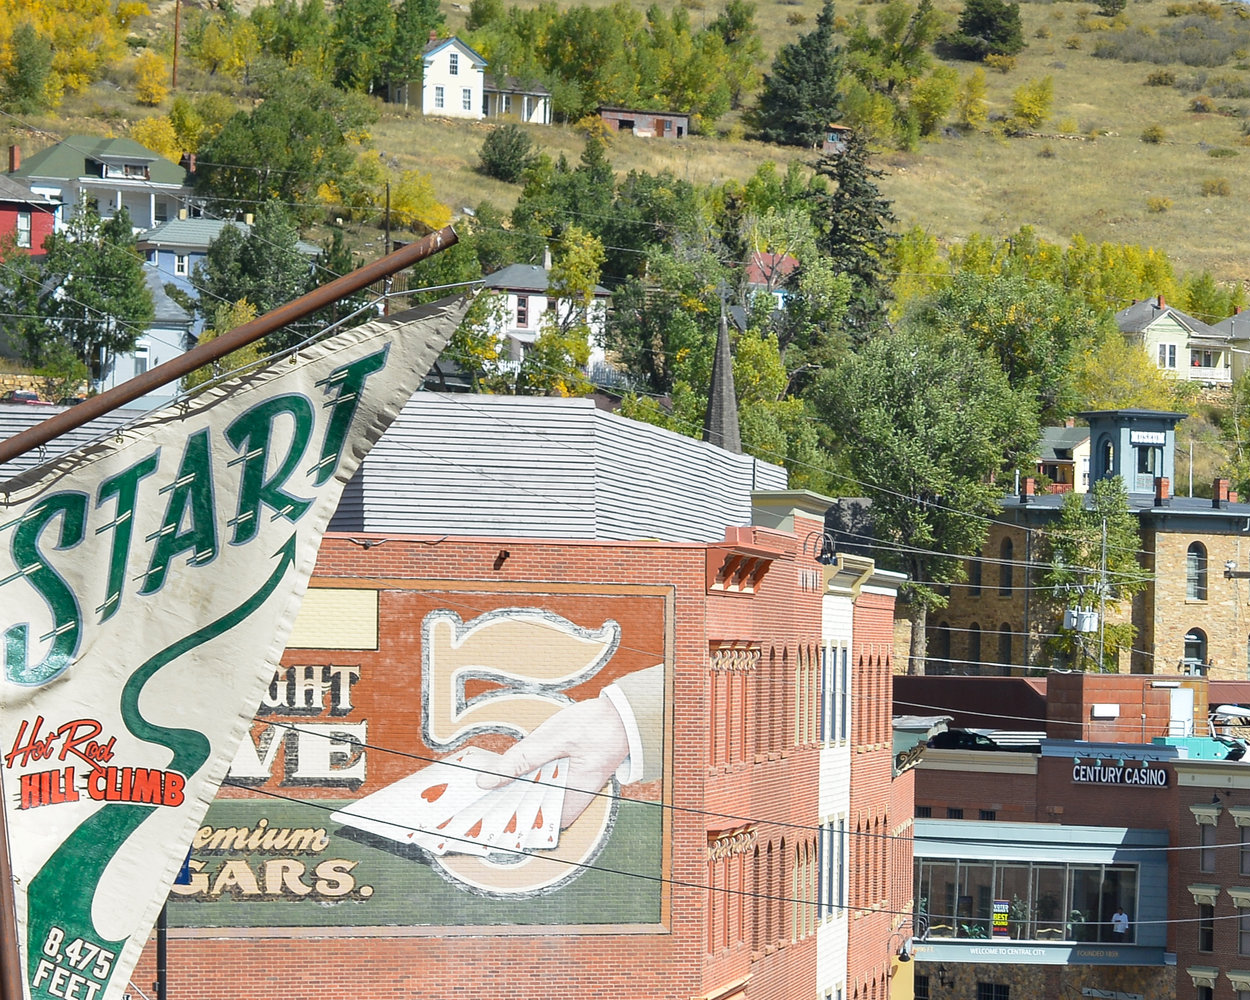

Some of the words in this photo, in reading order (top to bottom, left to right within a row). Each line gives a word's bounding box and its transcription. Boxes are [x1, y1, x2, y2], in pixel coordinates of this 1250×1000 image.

[2, 342, 391, 687] START
[5, 715, 55, 769] Hot
[57, 719, 117, 768] Rod
[227, 719, 367, 787] VE
[18, 767, 79, 810] HILL
[86, 767, 186, 807] CLIMB
[1072, 765, 1123, 783] CENTURY
[1125, 767, 1166, 786] CASINO
[192, 818, 330, 854] emium
[172, 857, 375, 900] GARS.
[993, 913, 1009, 921] BEST
[42, 927, 115, 979] 8,475
[969, 947, 998, 955] WELCOME
[1007, 948, 1032, 956] CENTRAL
[1032, 948, 1045, 957] CITY
